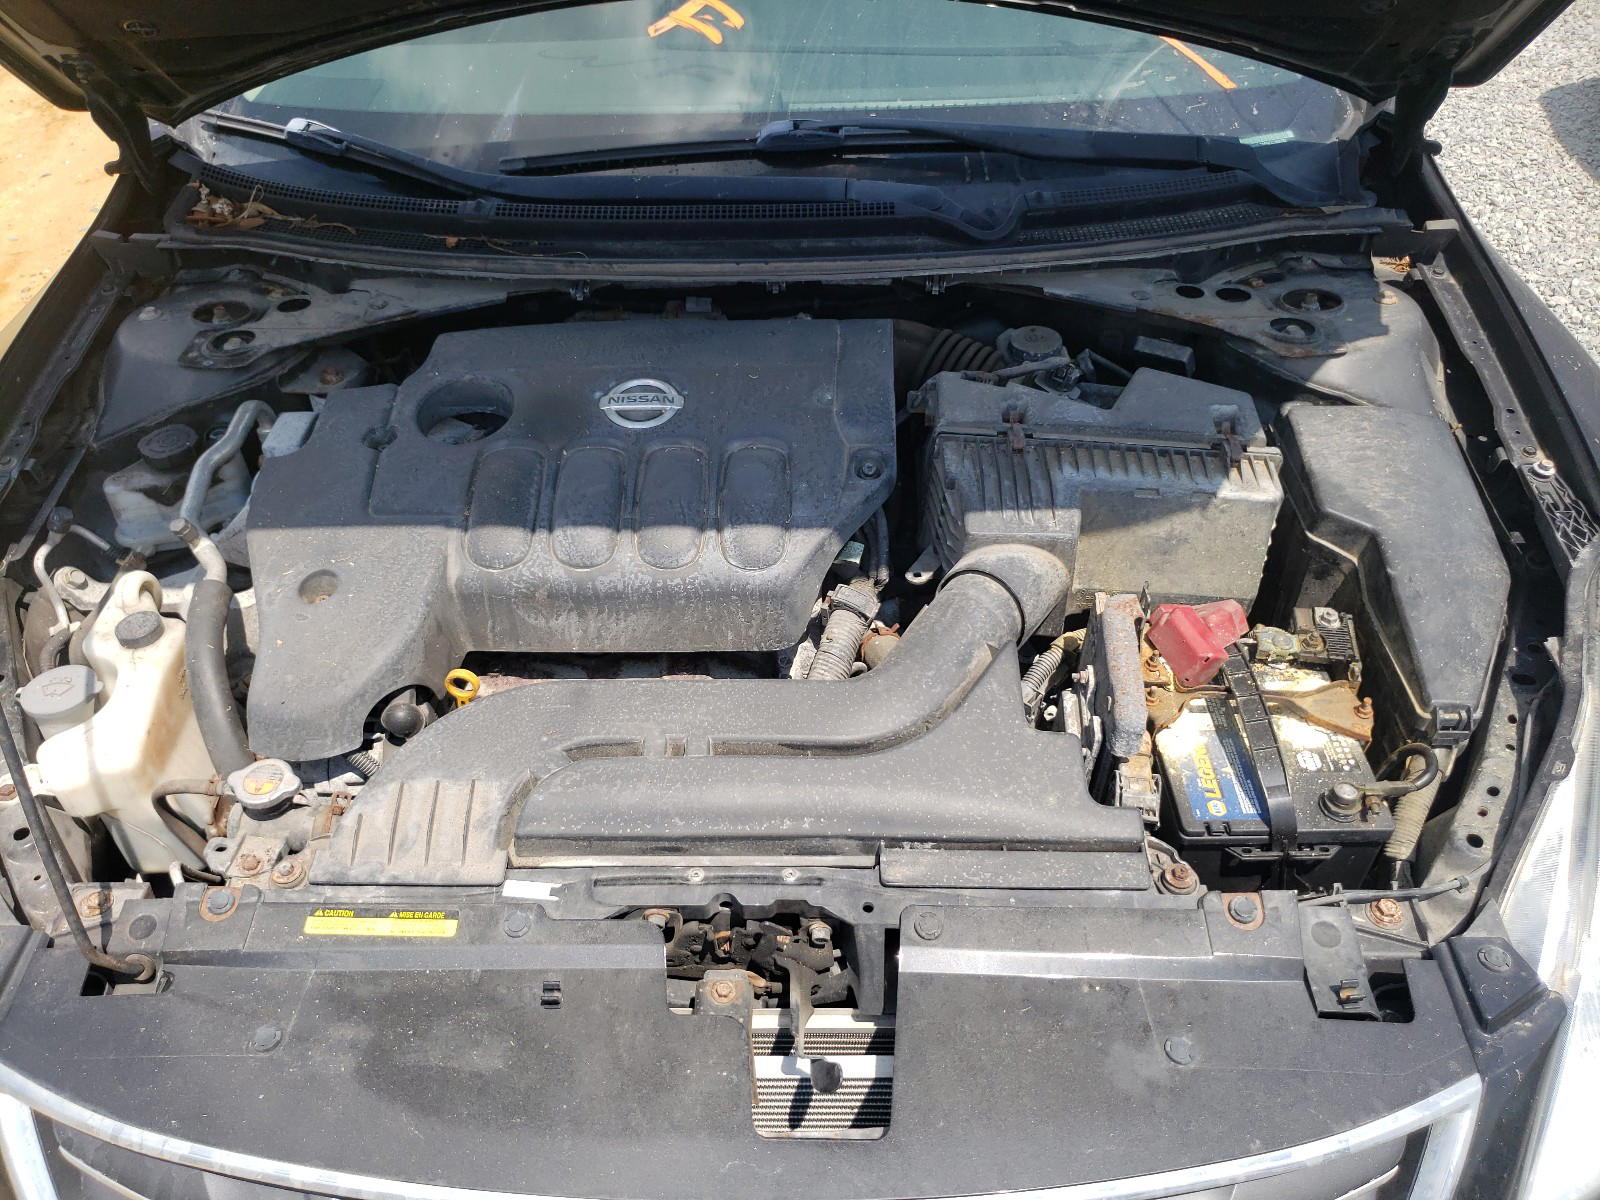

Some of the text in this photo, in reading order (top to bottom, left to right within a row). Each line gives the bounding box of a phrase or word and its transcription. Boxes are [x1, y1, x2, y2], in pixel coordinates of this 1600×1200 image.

[608, 395, 675, 405] NISSAN
[1195, 743, 1222, 798] LEGEN
[324, 909, 354, 917] CAUTION
[399, 911, 415, 919] MISE
[424, 911, 446, 919] GARDE
